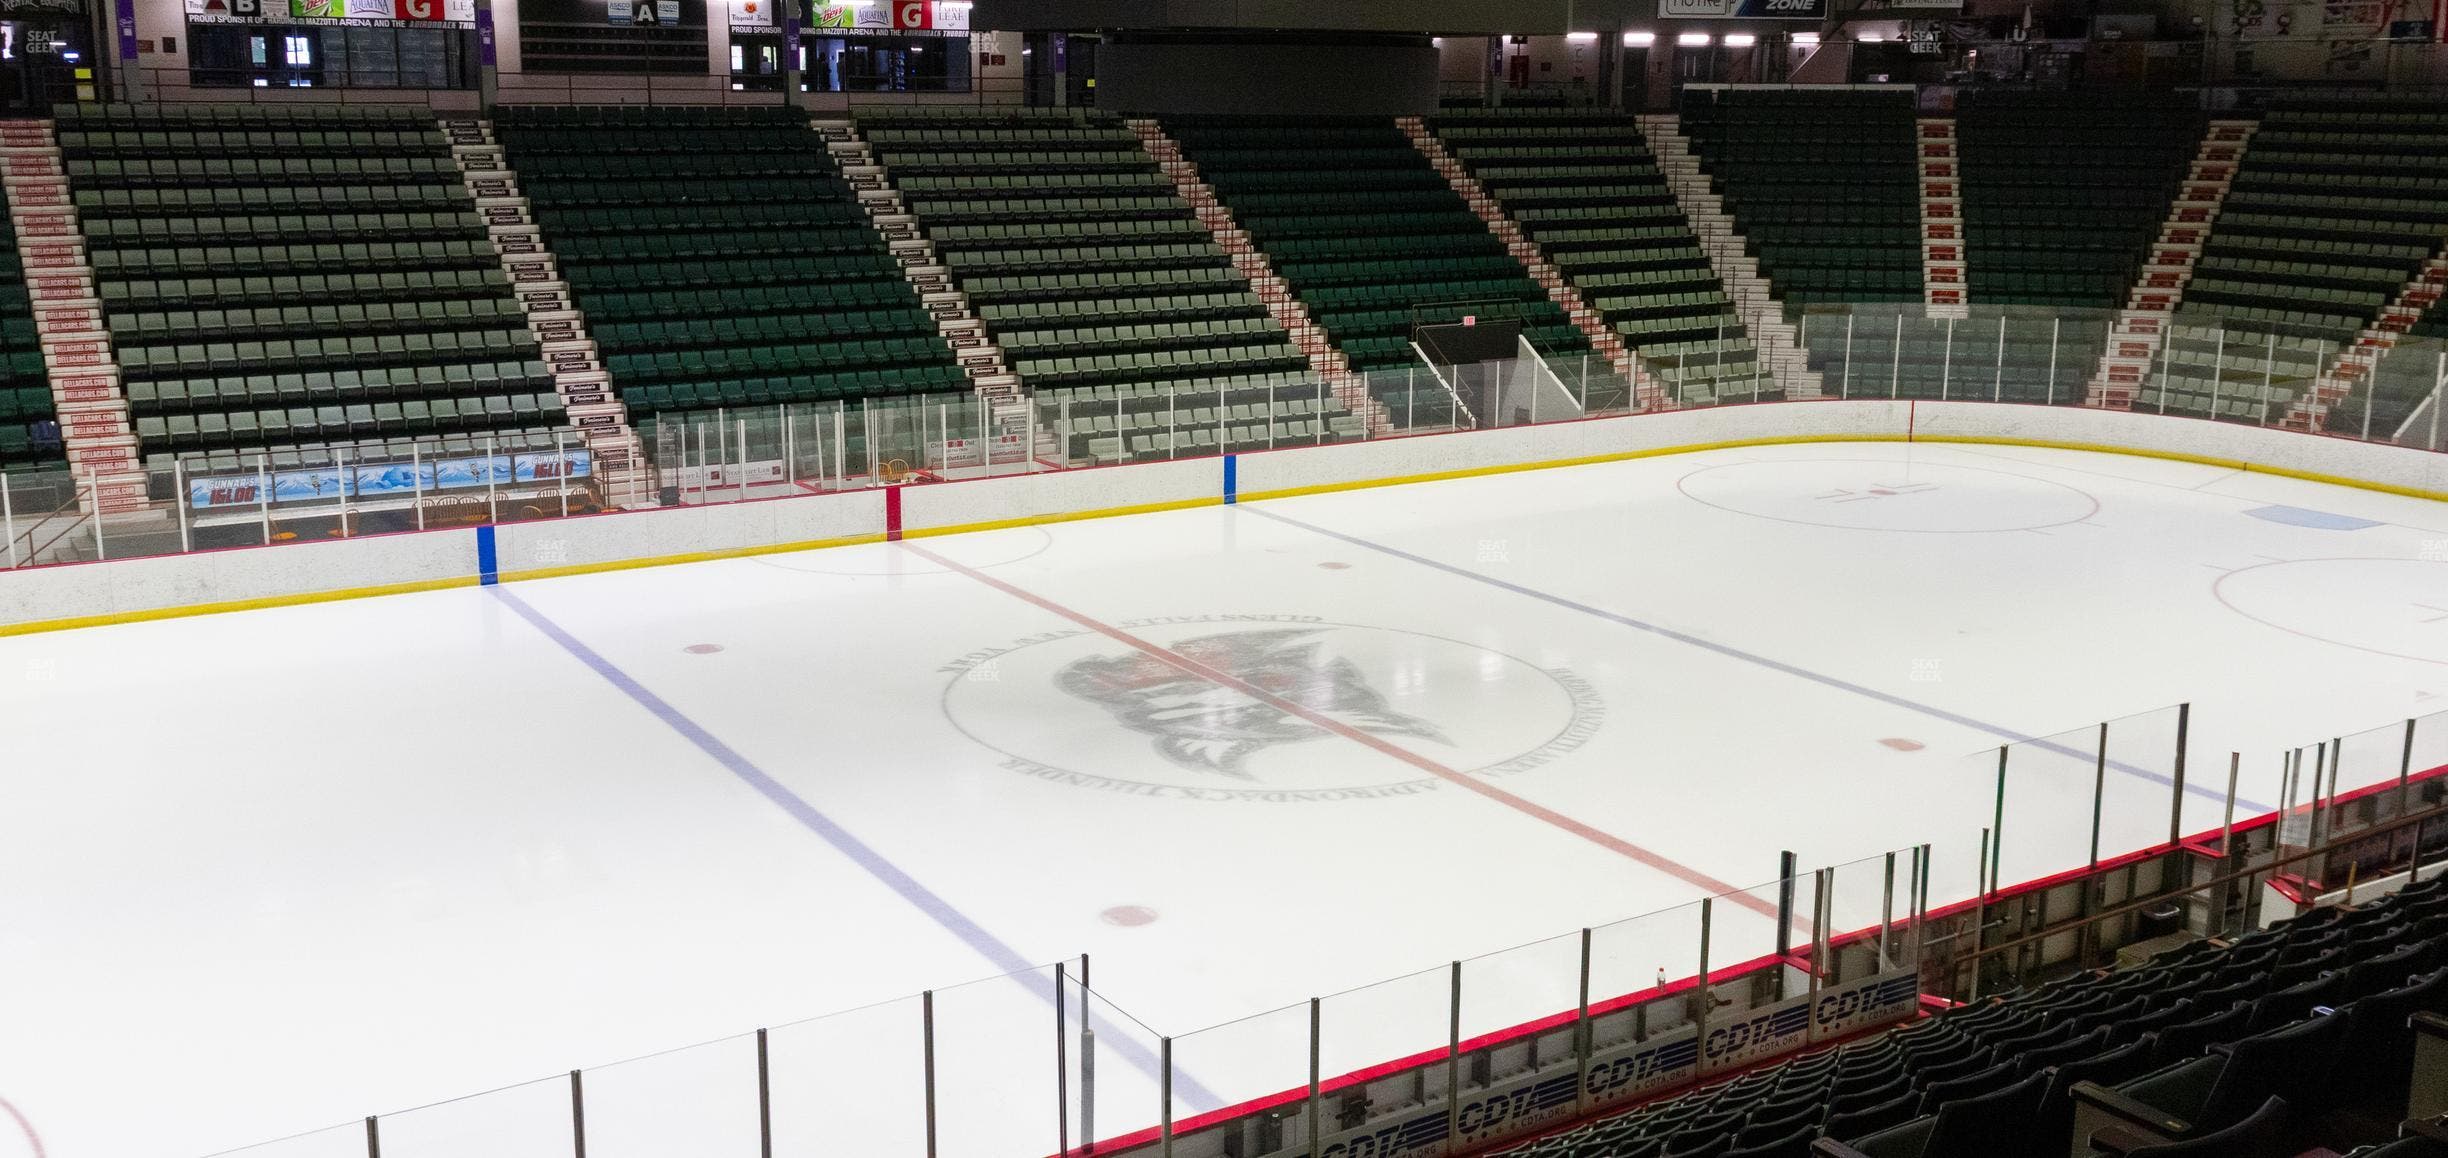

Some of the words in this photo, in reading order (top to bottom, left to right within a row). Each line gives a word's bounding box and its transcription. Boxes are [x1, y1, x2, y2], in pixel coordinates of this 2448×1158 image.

[406, 0, 431, 18] G
[638, 4, 655, 21] A
[902, 4, 922, 27] G
[189, 15, 215, 23] PROUD
[306, 18, 338, 27] MAZZOTTI
[339, 19, 371, 27] ARENA
[392, 20, 406, 28] THE
[732, 26, 752, 34] PROUD
[996, 758, 1167, 797] THUNDER
[1179, 779, 1439, 802] ADIRONDACK
[1817, 983, 1886, 1025] CDTA
[1705, 1014, 1778, 1058] CDTA
[1759, 1034, 1799, 1053] CDTA.ORG
[1586, 1048, 1664, 1094] CDTA
[1645, 1069, 1687, 1089] CDTA.ORG
[1458, 1084, 1542, 1135] CDTA
[1521, 1106, 1567, 1128] CDTA.ORG
